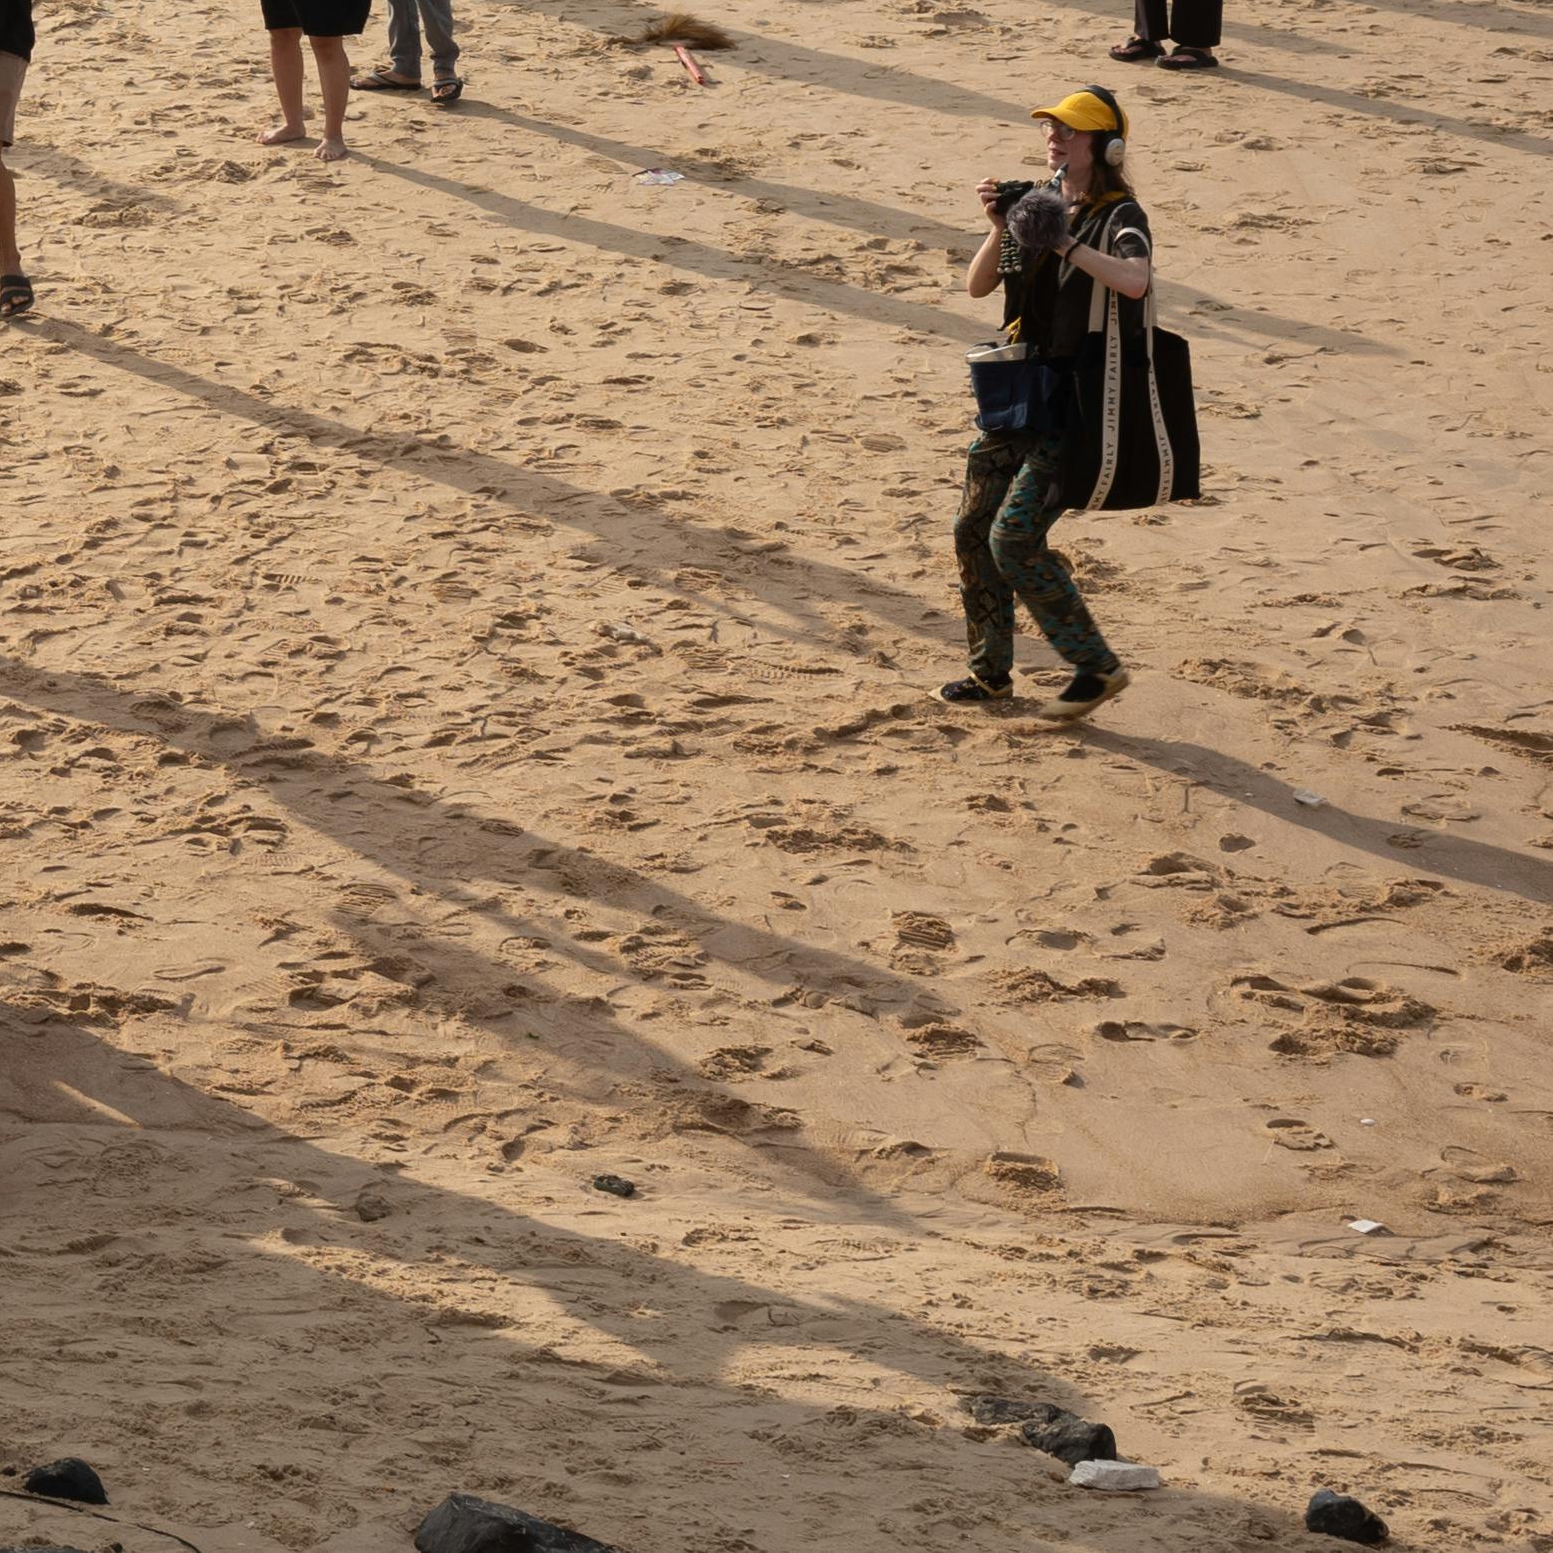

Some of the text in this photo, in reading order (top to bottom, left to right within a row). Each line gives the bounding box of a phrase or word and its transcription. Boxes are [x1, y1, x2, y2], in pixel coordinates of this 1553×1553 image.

[1108, 334, 1119, 382] FAIRLY
[1106, 386, 1118, 432] JIMMY
[1100, 441, 1114, 490] FAIRLY
